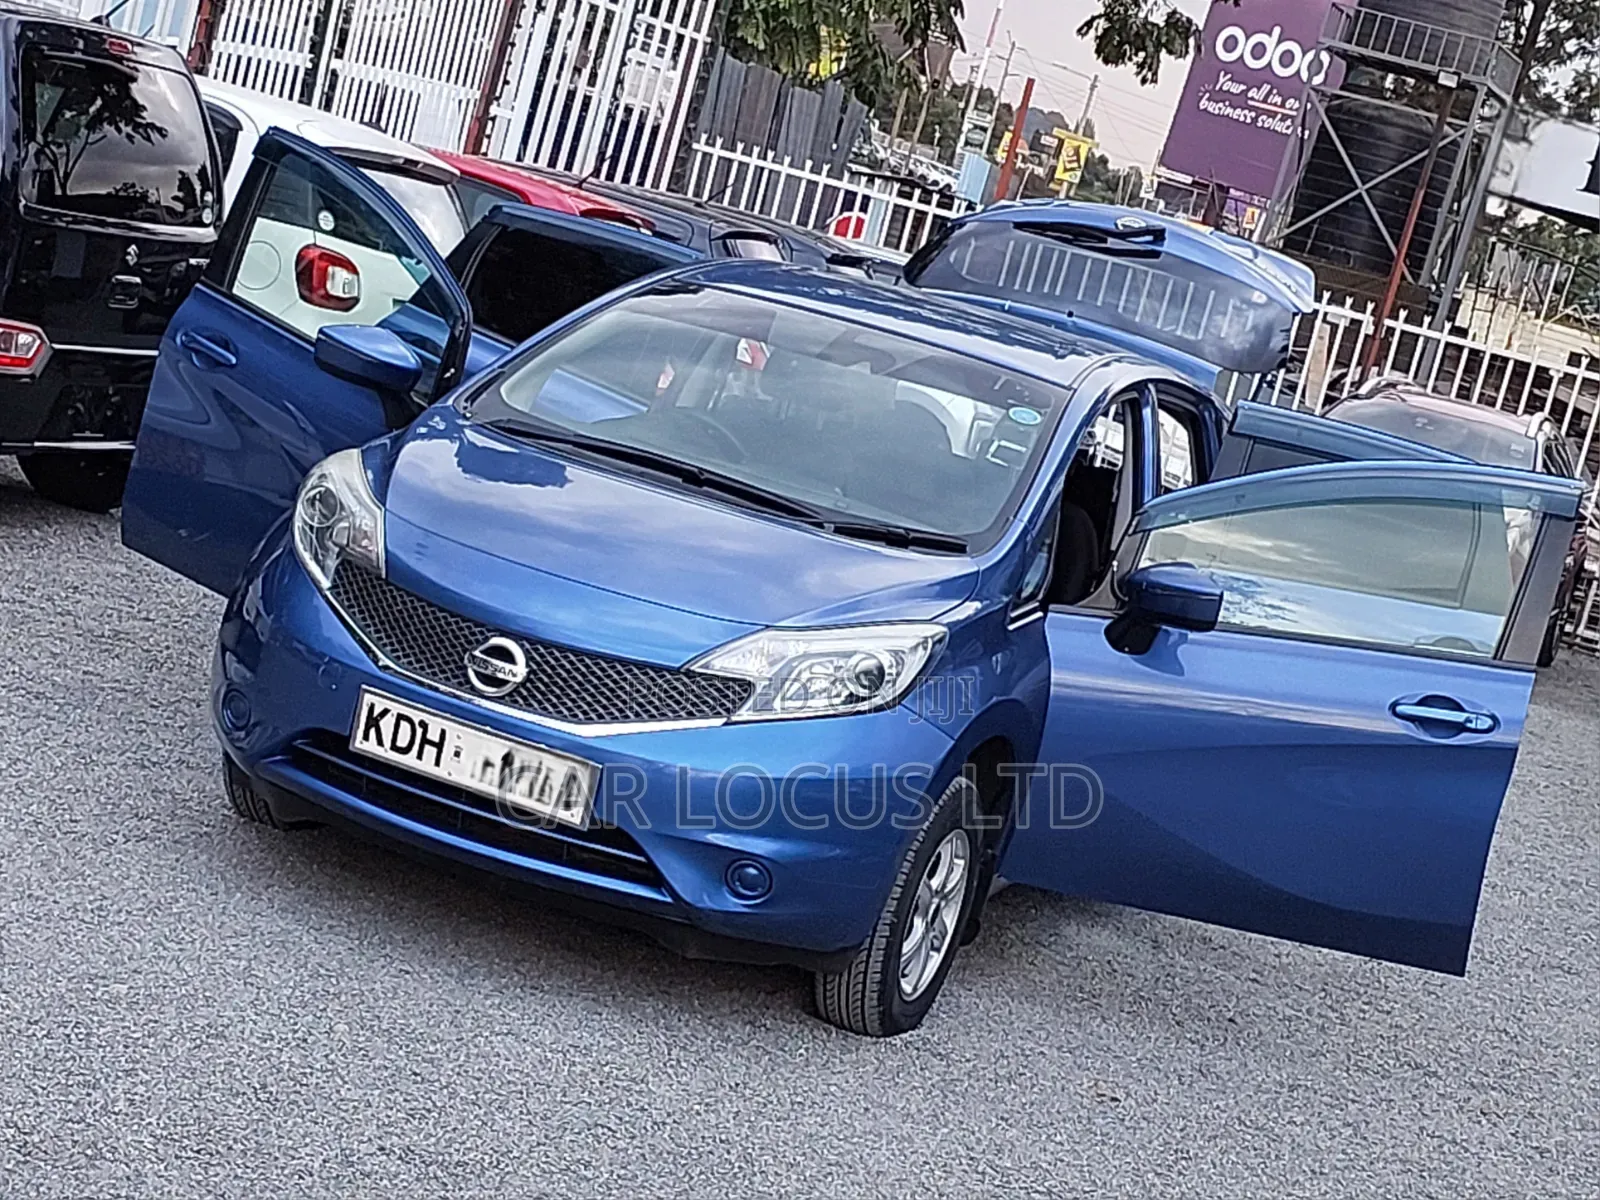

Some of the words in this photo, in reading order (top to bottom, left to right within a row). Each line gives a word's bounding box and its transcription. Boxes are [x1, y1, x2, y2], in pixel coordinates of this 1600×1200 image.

[1215, 25, 1331, 86] odoo
[1199, 92, 1256, 124] business
[1214, 70, 1247, 95] Your
[1247, 83, 1272, 101] all
[1267, 89, 1283, 106] in
[1284, 97, 1312, 110] on
[361, 701, 447, 768] KDH
